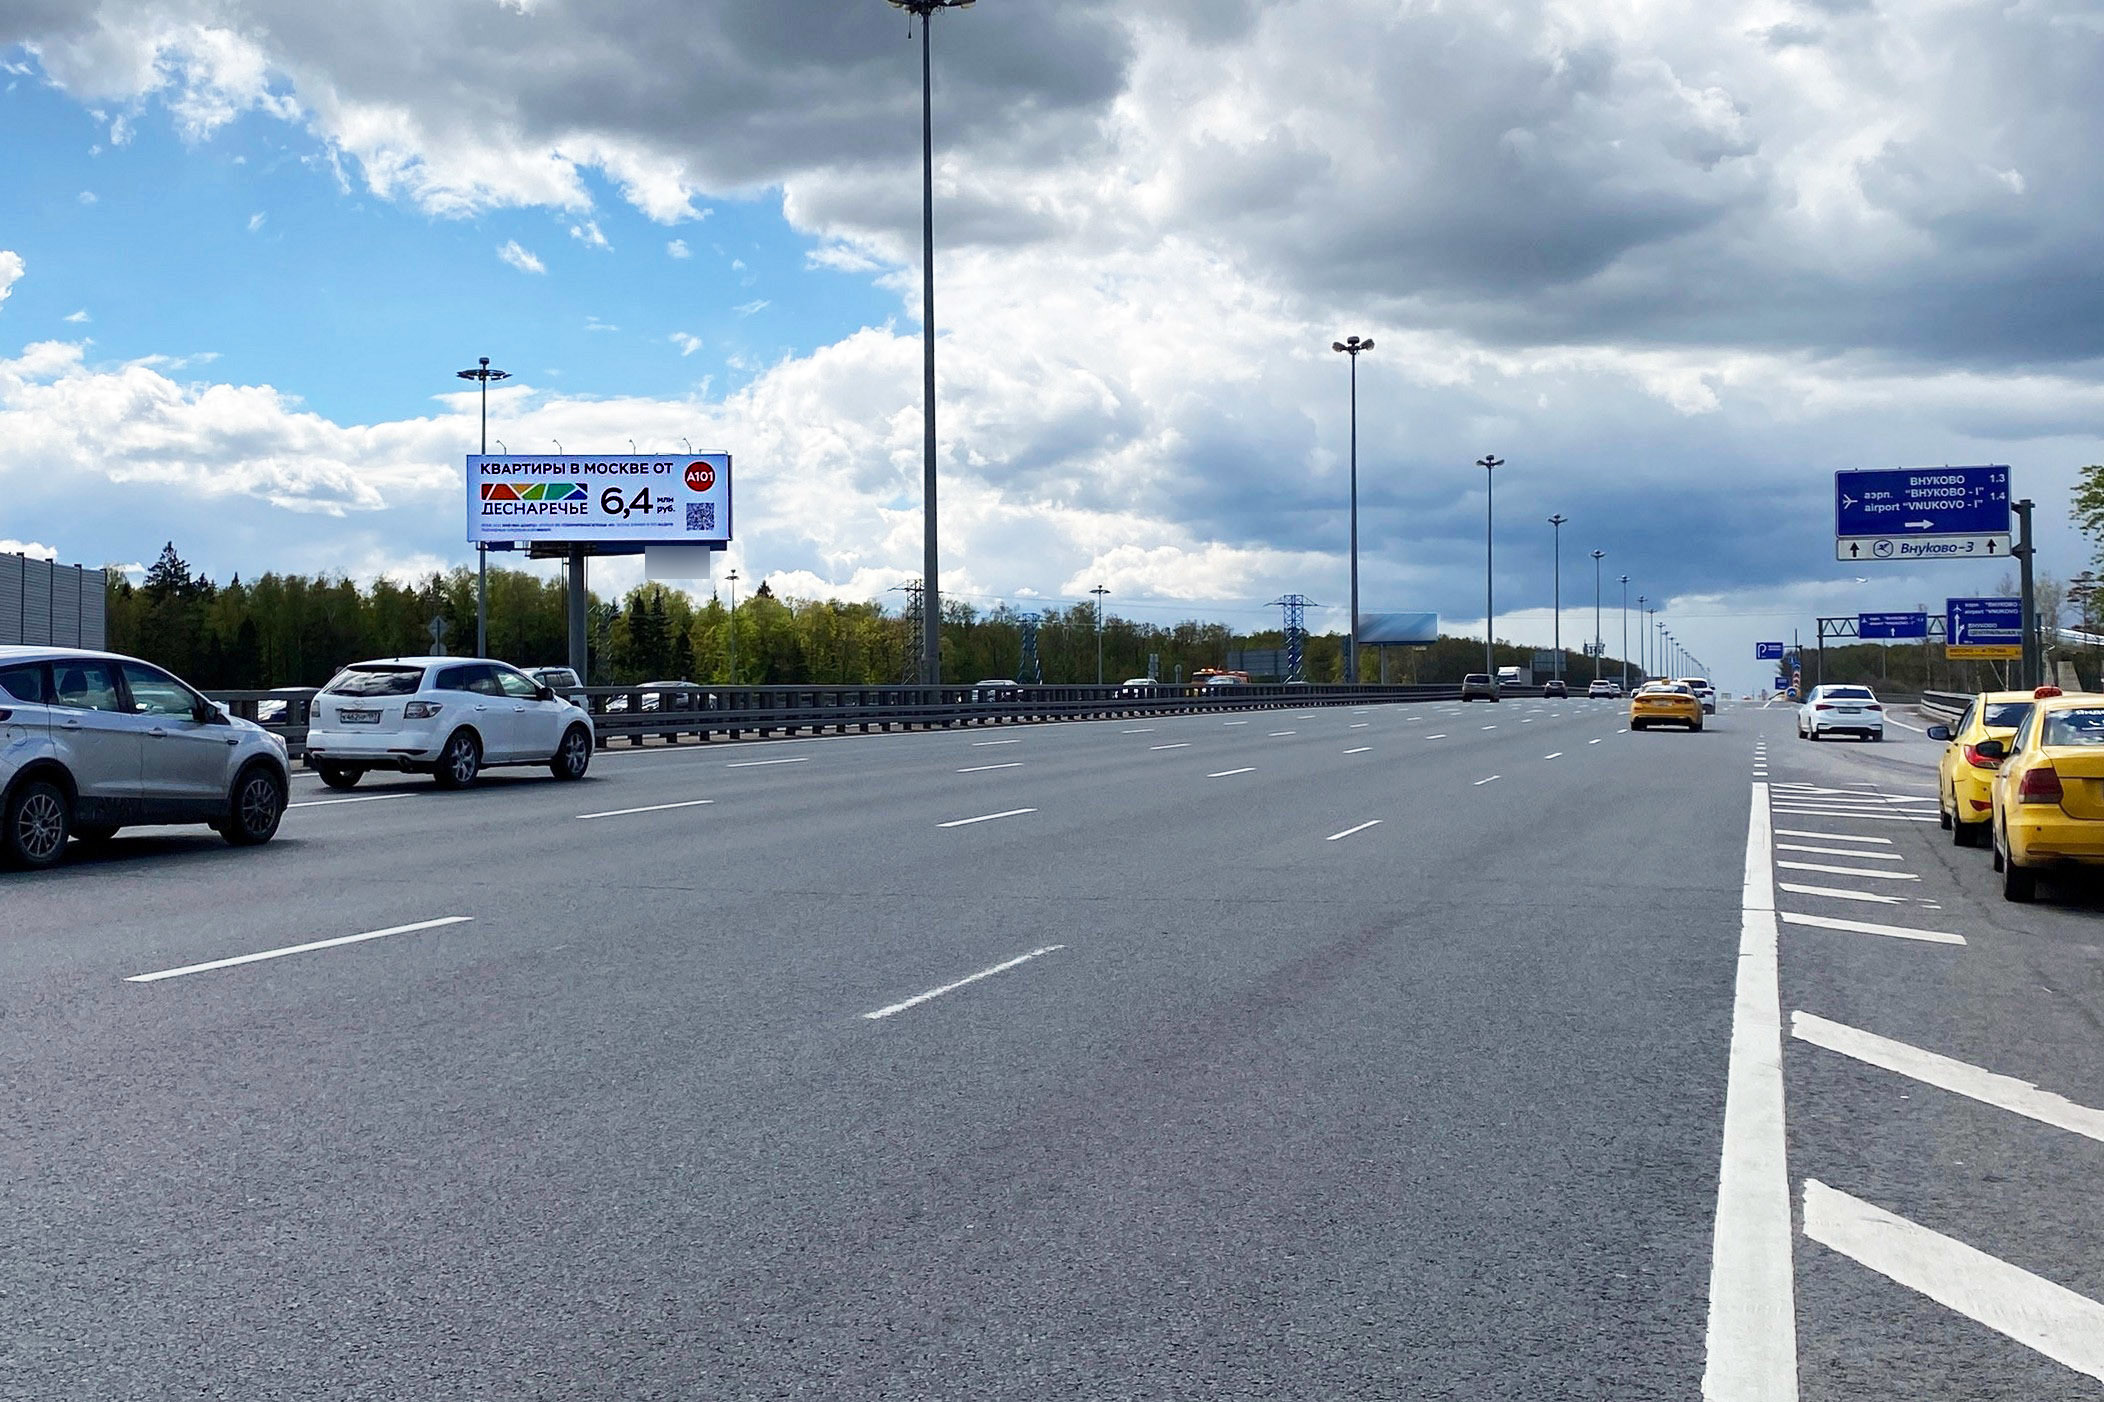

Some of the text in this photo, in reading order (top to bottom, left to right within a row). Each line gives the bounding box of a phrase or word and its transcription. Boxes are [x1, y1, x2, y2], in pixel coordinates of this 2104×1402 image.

[480, 462, 673, 474] КВАРТИРЫ В МОСКВЕ ОТ
[1909, 473, 2005, 486] ВНУКОВО 1.3
[1864, 491, 1893, 500] аэрп.
[1990, 492, 2006, 501] 1.4
[481, 502, 588, 515] ДЕСНАРЕЧЬЕ
[601, 487, 653, 519] 6,4
[1864, 502, 1900, 513] airport
[656, 505, 676, 514] руб.
